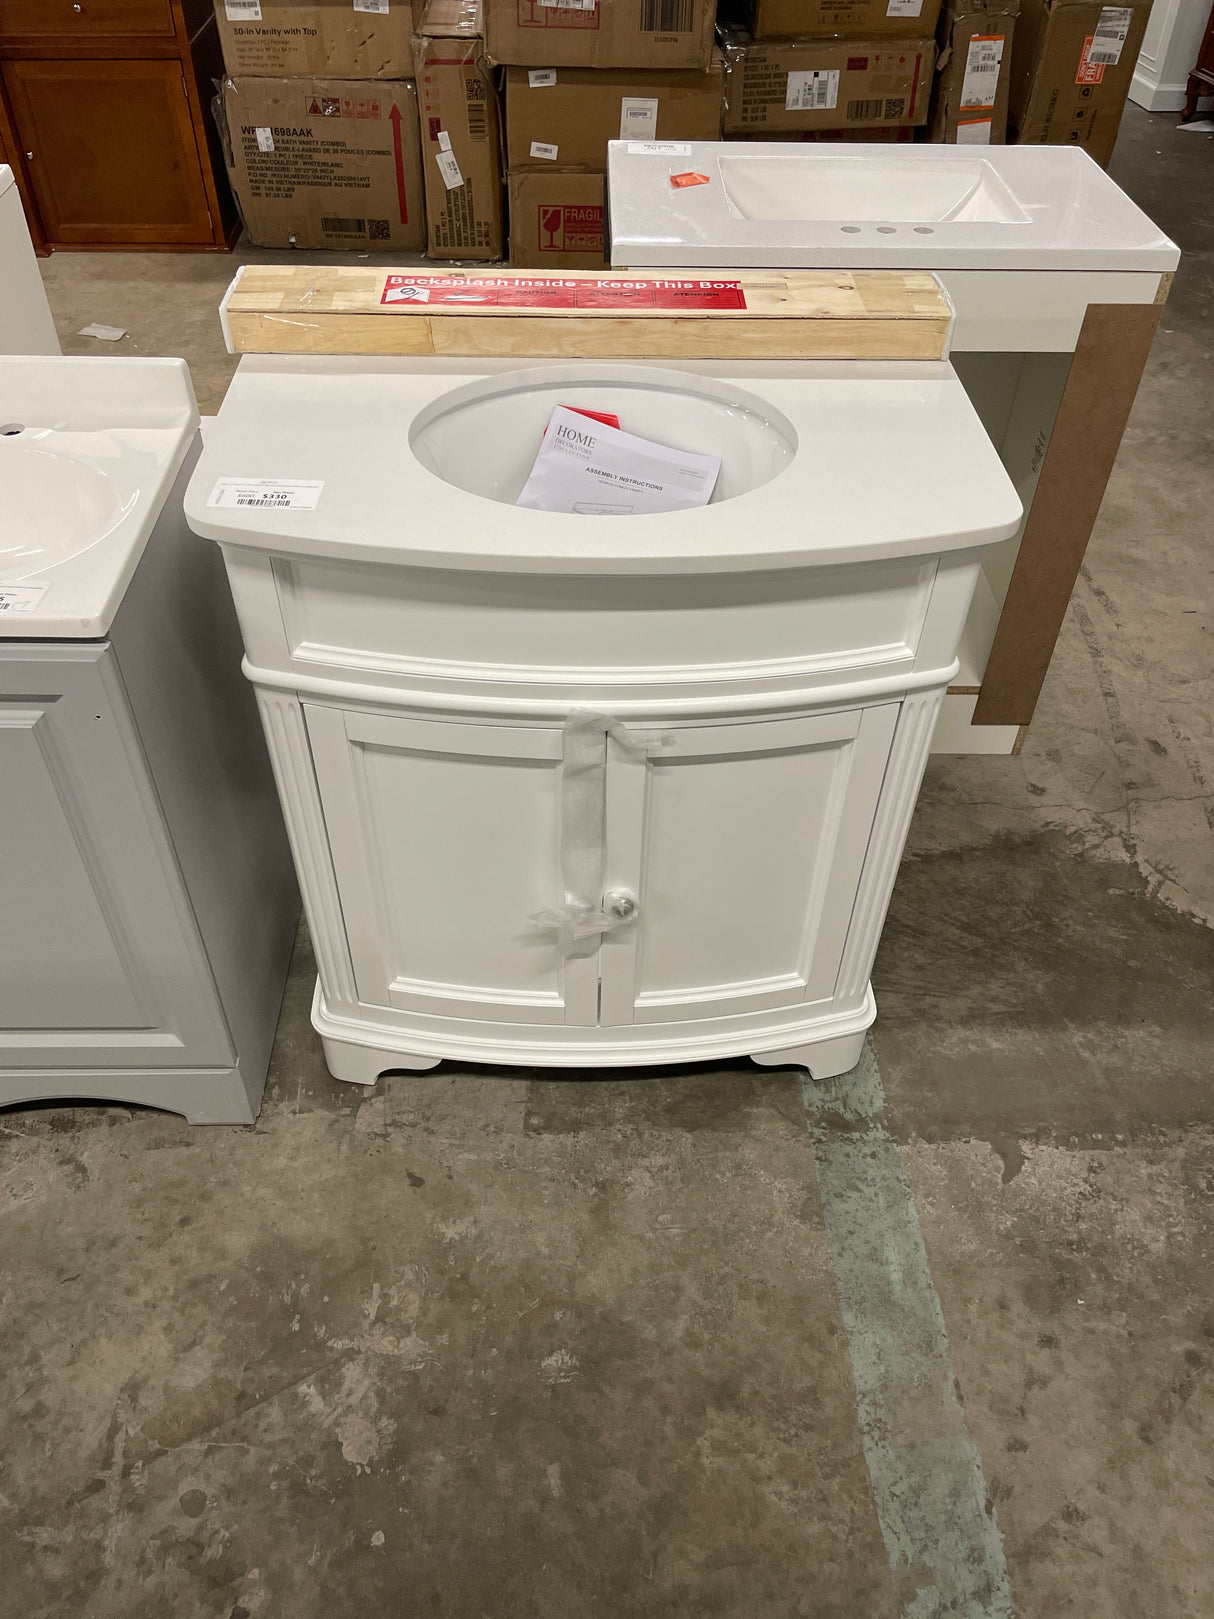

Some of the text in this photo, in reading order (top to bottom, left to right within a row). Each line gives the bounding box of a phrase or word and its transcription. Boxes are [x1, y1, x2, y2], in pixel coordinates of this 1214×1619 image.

[255, 28, 281, 36] Vanity
[303, 28, 317, 36] Top
[241, 126, 313, 138] WF1698AAK
[565, 209, 603, 221] FRAGIL
[390, 277, 508, 290] Backsplash
[514, 279, 576, 288] Inside
[597, 281, 647, 290] Keep
[700, 281, 737, 289] Box
[557, 425, 597, 448] HOME
[555, 438, 592, 455] DECORATORS
[585, 466, 664, 492] ASSEMBLY INSTRUCTIONS
